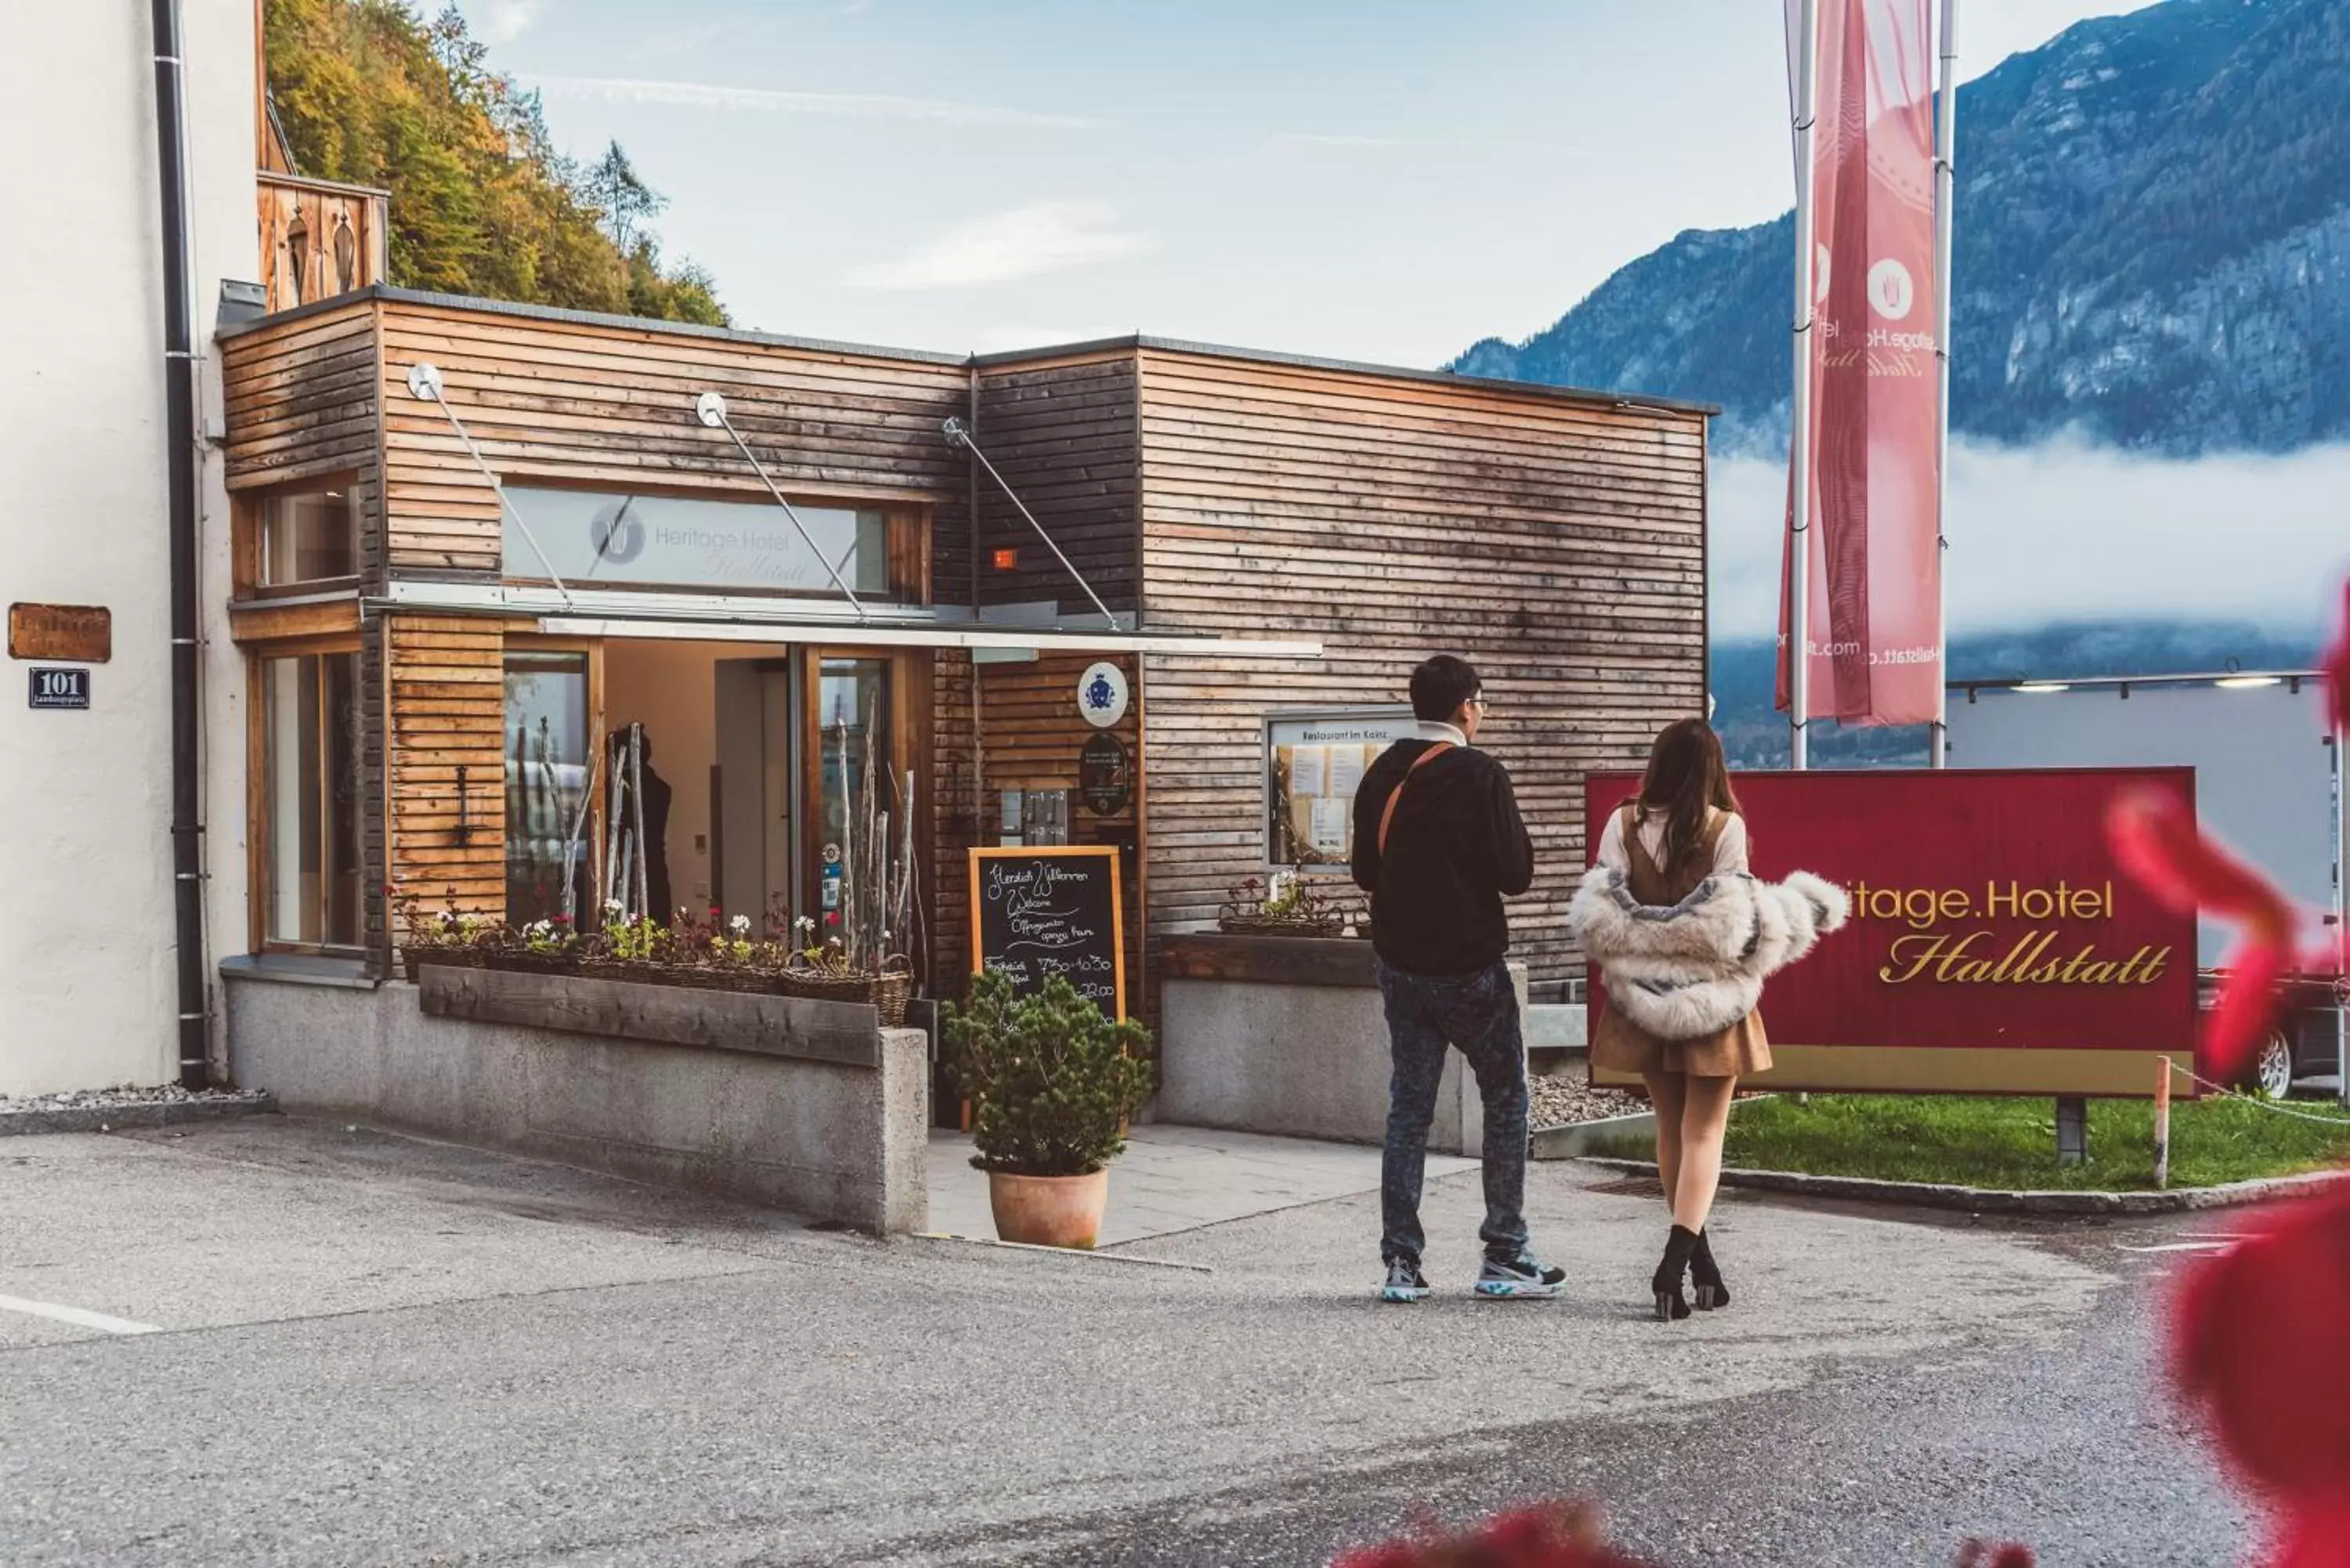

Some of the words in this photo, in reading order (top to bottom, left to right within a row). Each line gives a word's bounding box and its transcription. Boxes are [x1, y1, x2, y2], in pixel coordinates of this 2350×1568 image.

[40, 672, 79, 695] 101
[1303, 730, 1348, 740] Restaurant
[1846, 879, 2113, 929] itage.Hotel
[1880, 930, 2172, 985] Hallstatt
